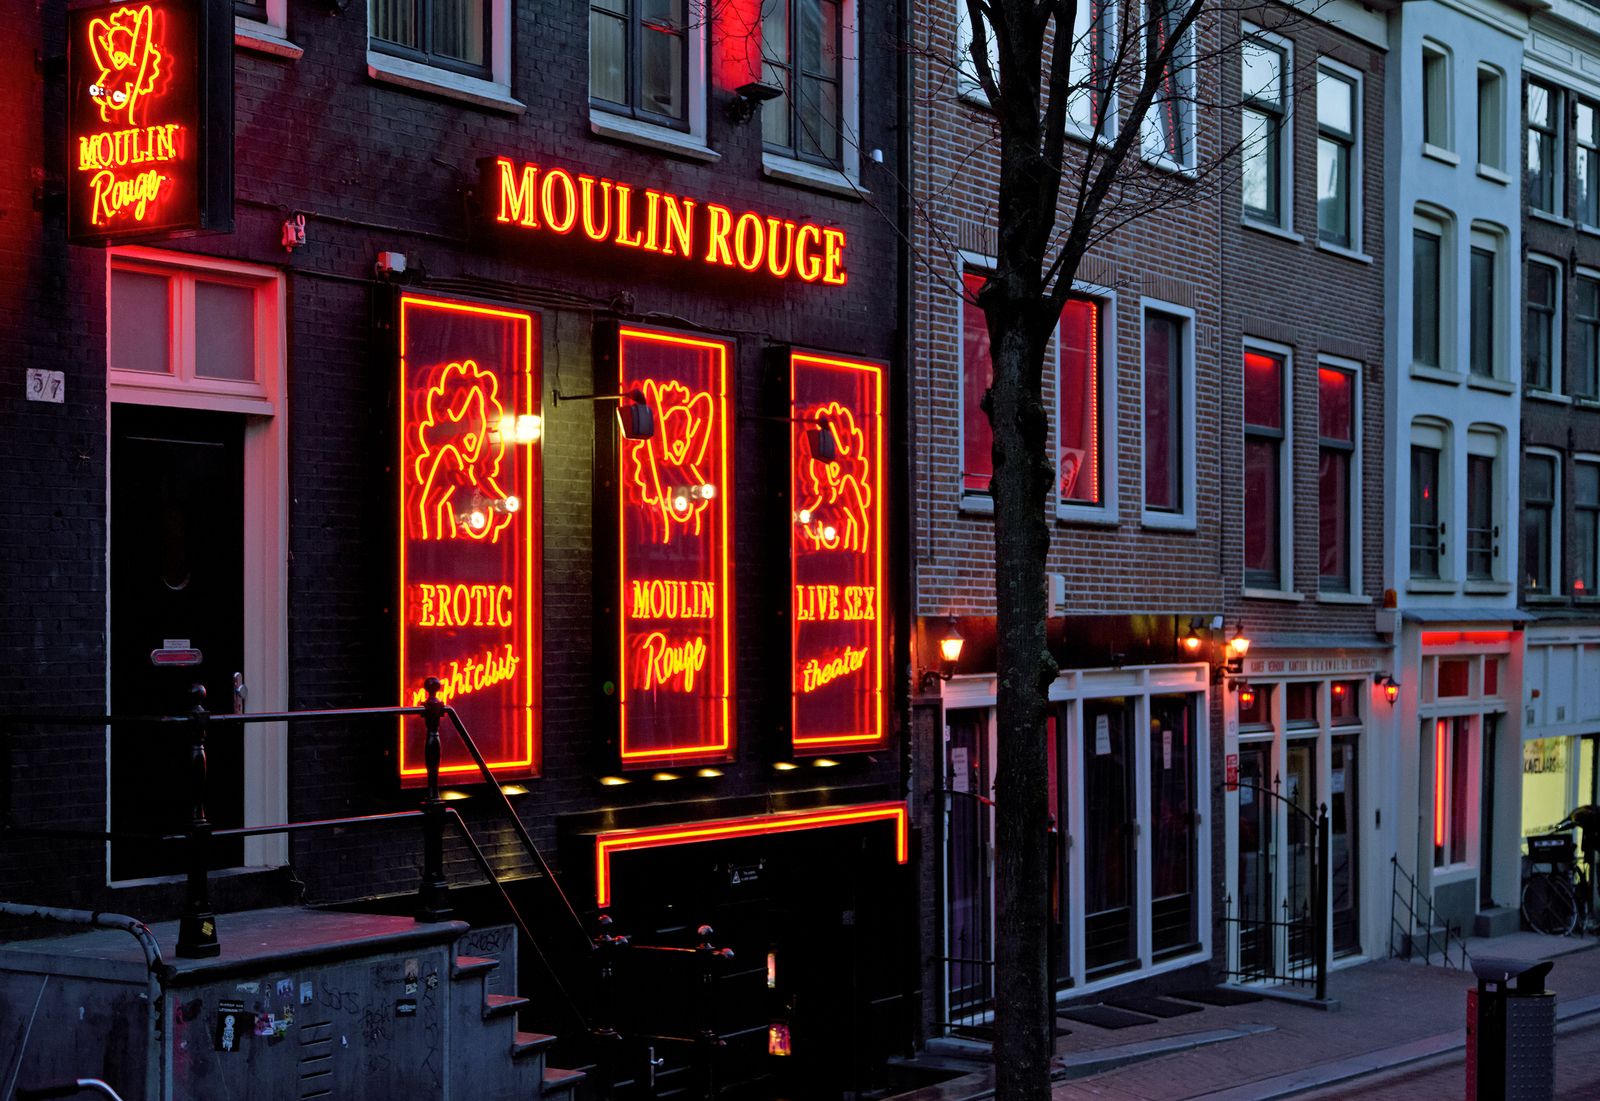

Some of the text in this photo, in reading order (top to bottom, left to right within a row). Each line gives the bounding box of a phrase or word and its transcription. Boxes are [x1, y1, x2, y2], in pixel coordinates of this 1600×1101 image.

[79, 124, 178, 170] MOULIN
[89, 169, 167, 225] Rouge
[496, 157, 846, 286] MOULIN ROUGE
[33, 373, 61, 399] 5/7
[418, 583, 513, 628] EROTIC
[631, 579, 715, 619] MOULIN
[795, 584, 876, 621] LIVE SEX
[412, 643, 520, 708] nghtclub
[642, 631, 707, 693] Rouge
[803, 645, 869, 693] theater
